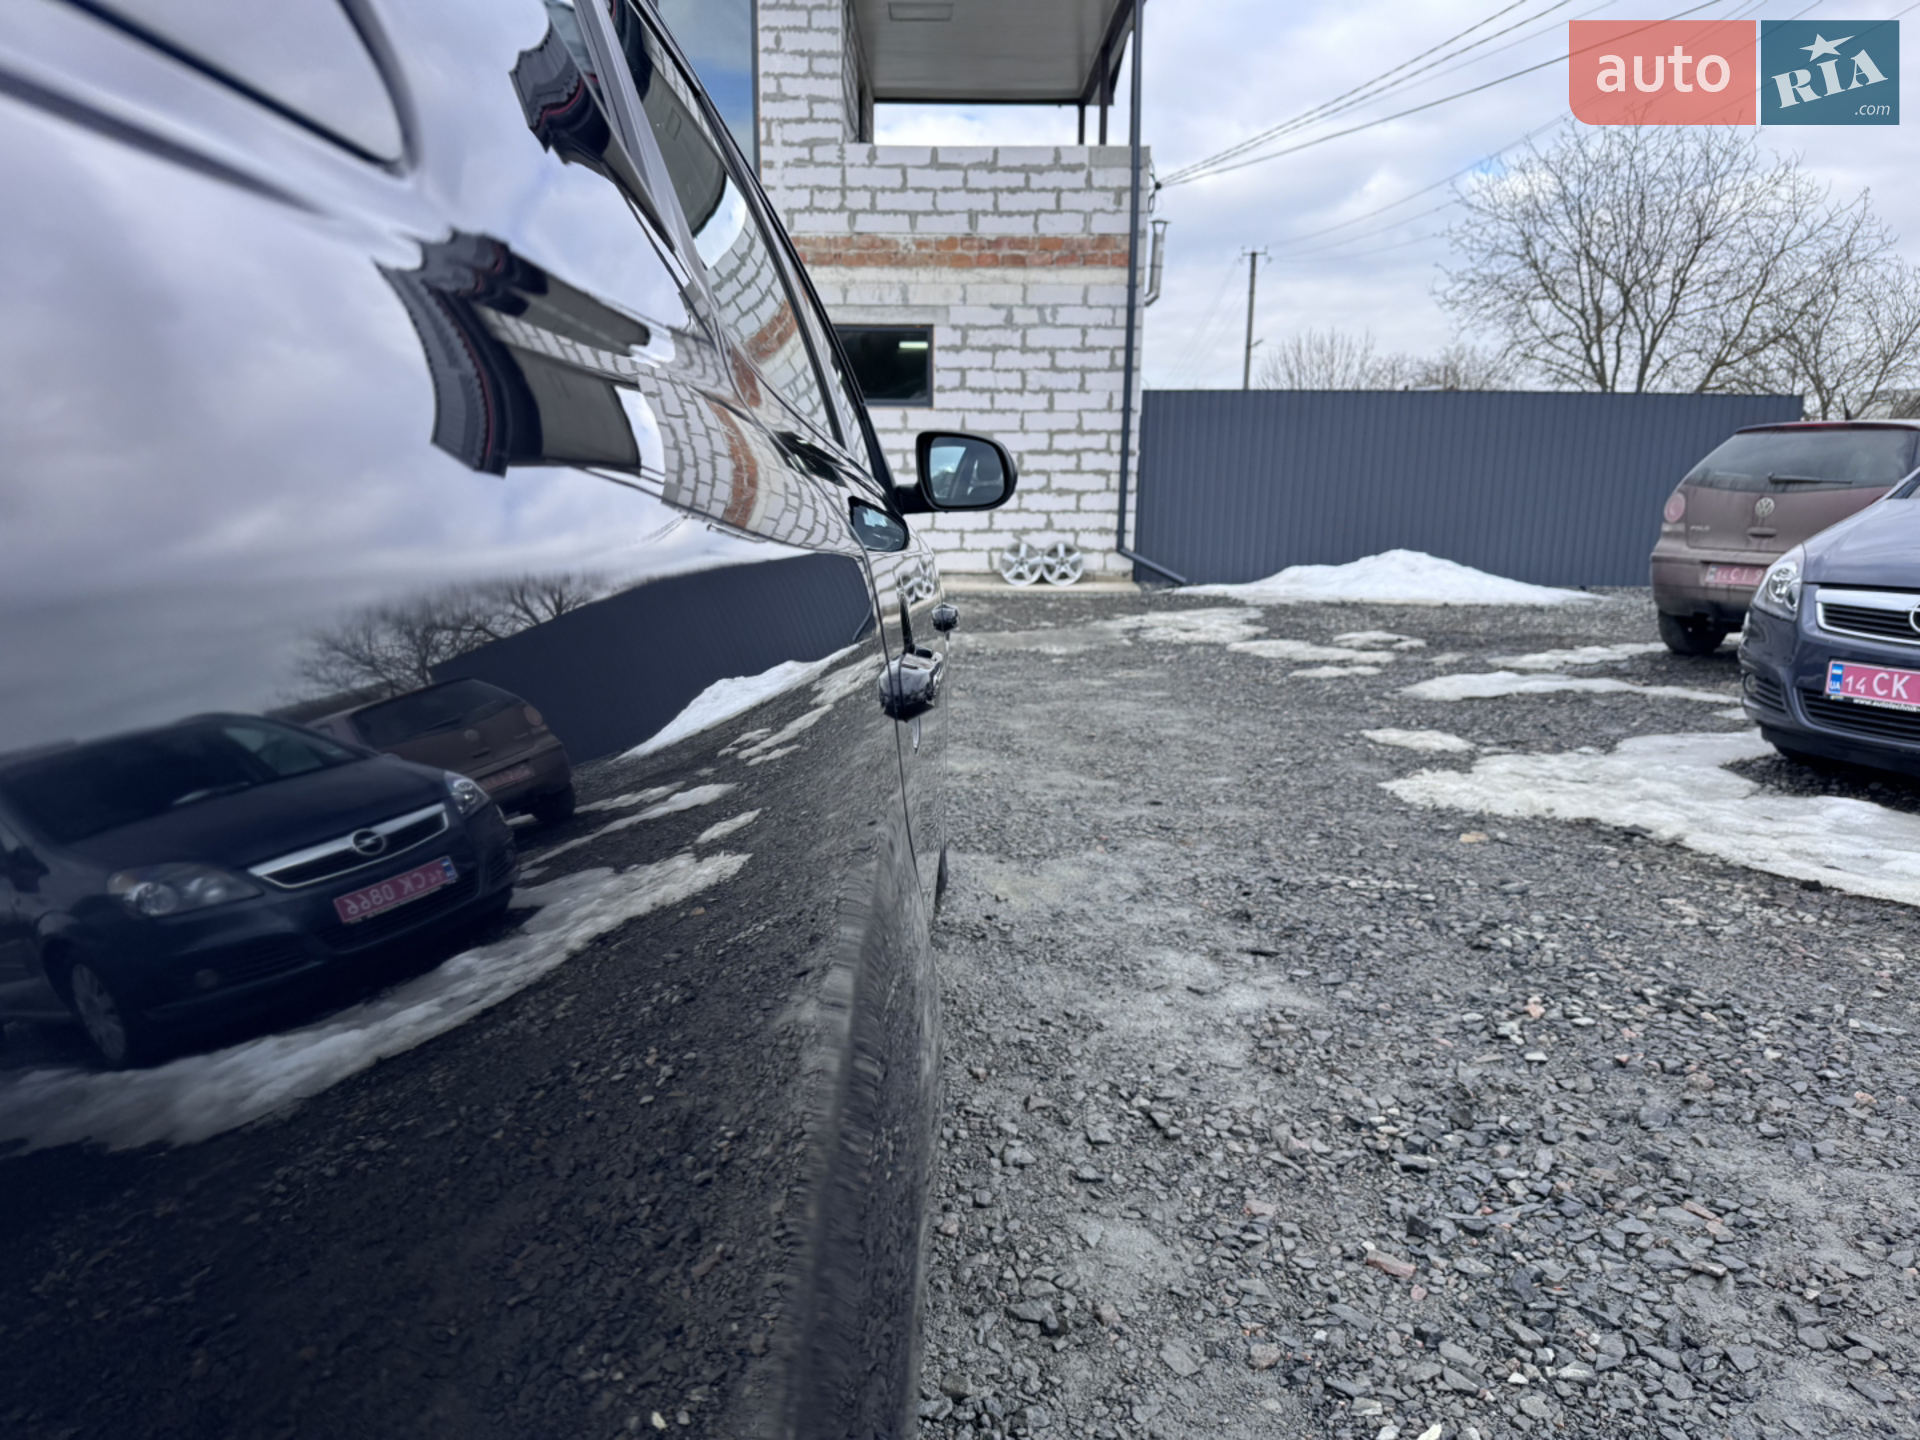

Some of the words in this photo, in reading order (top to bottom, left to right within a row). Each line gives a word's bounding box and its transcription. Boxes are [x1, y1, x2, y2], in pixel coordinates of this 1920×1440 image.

[1829, 681, 1841, 690] UA
[1845, 675, 1867, 694] 14
[1873, 672, 1911, 700] CK
